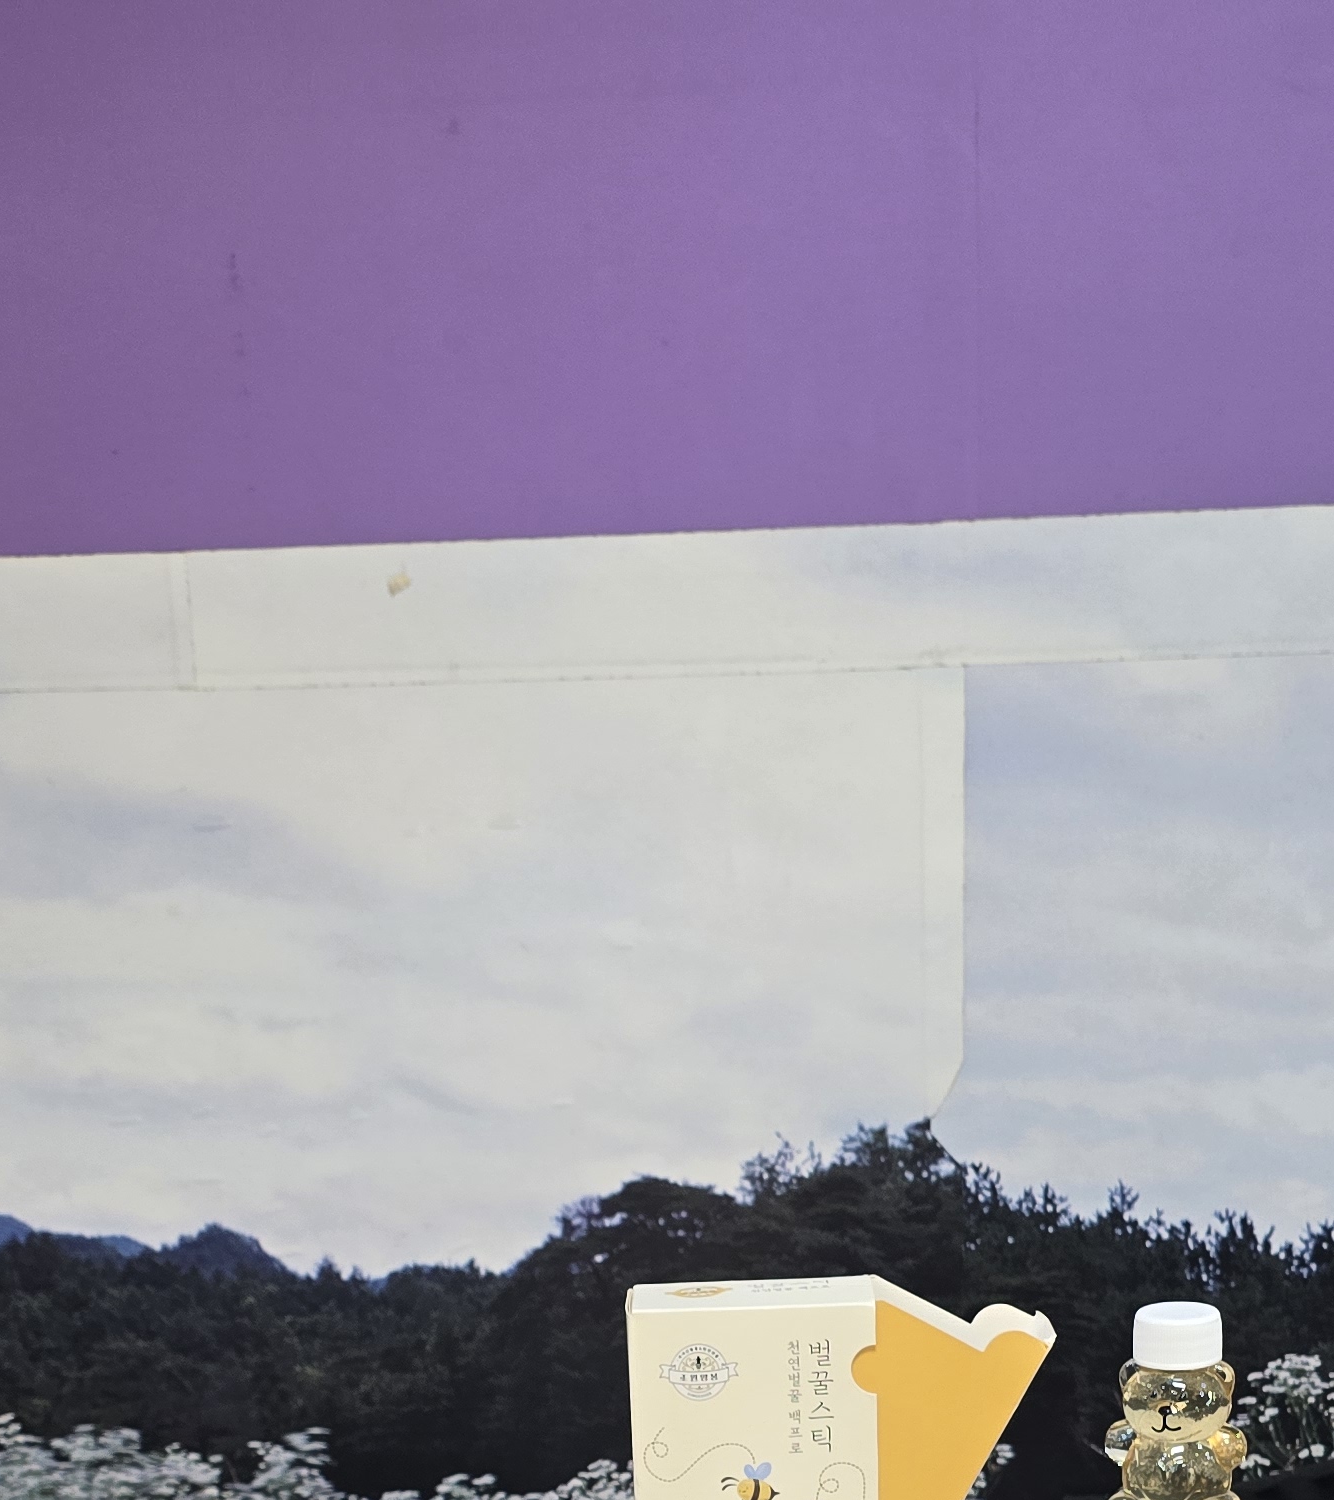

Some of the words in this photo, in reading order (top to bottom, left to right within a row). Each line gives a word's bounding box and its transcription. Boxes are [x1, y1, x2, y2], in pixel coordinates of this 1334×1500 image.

[787, 1339, 803, 1404] 천연벌꿀
[807, 1338, 835, 1453] 벌꿀스틱
[788, 1409, 804, 1454] 백프로
